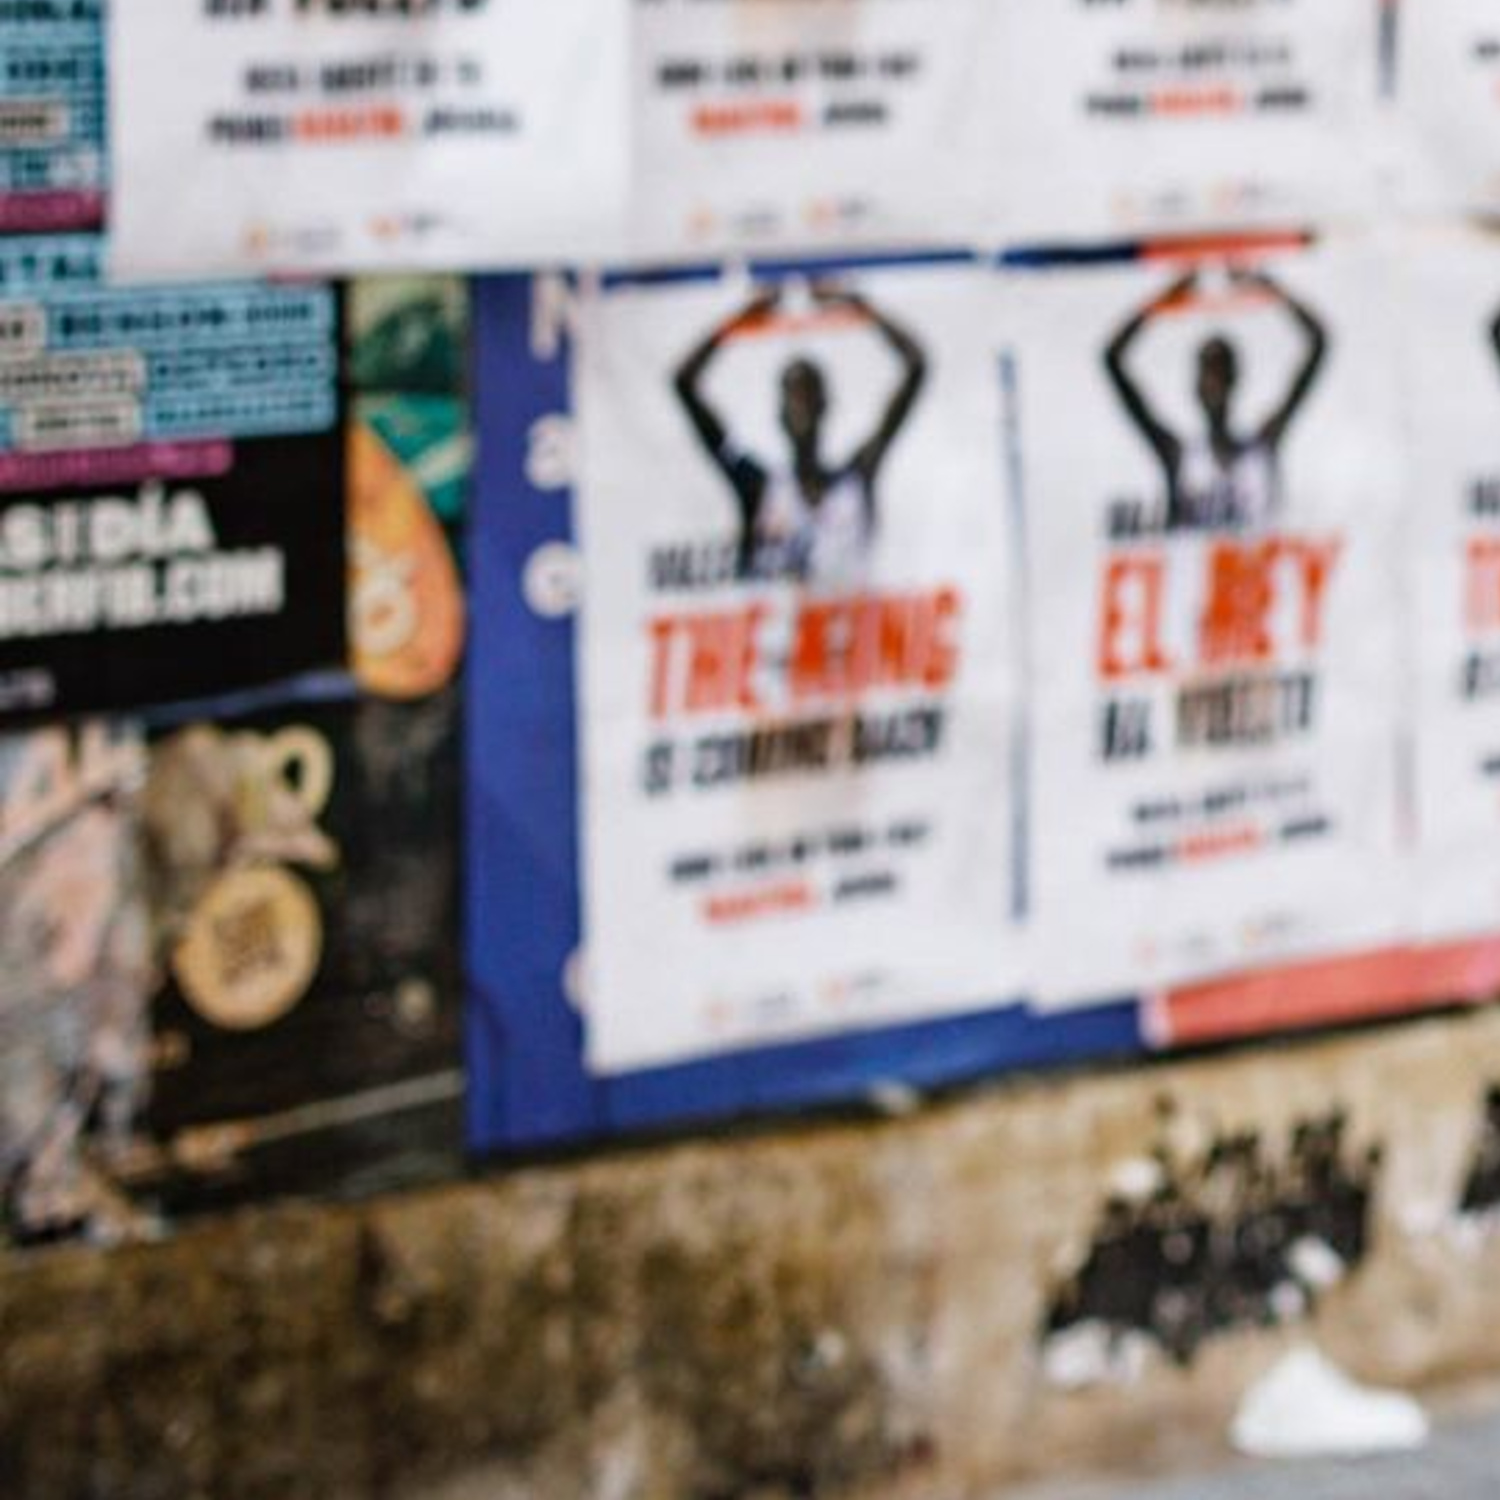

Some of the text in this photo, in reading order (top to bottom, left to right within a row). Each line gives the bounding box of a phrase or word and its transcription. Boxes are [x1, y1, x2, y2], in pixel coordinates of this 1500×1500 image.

[90, 476, 216, 562] DÍA
[648, 582, 962, 722] THE KING
[1098, 530, 1346, 682] EL REY
